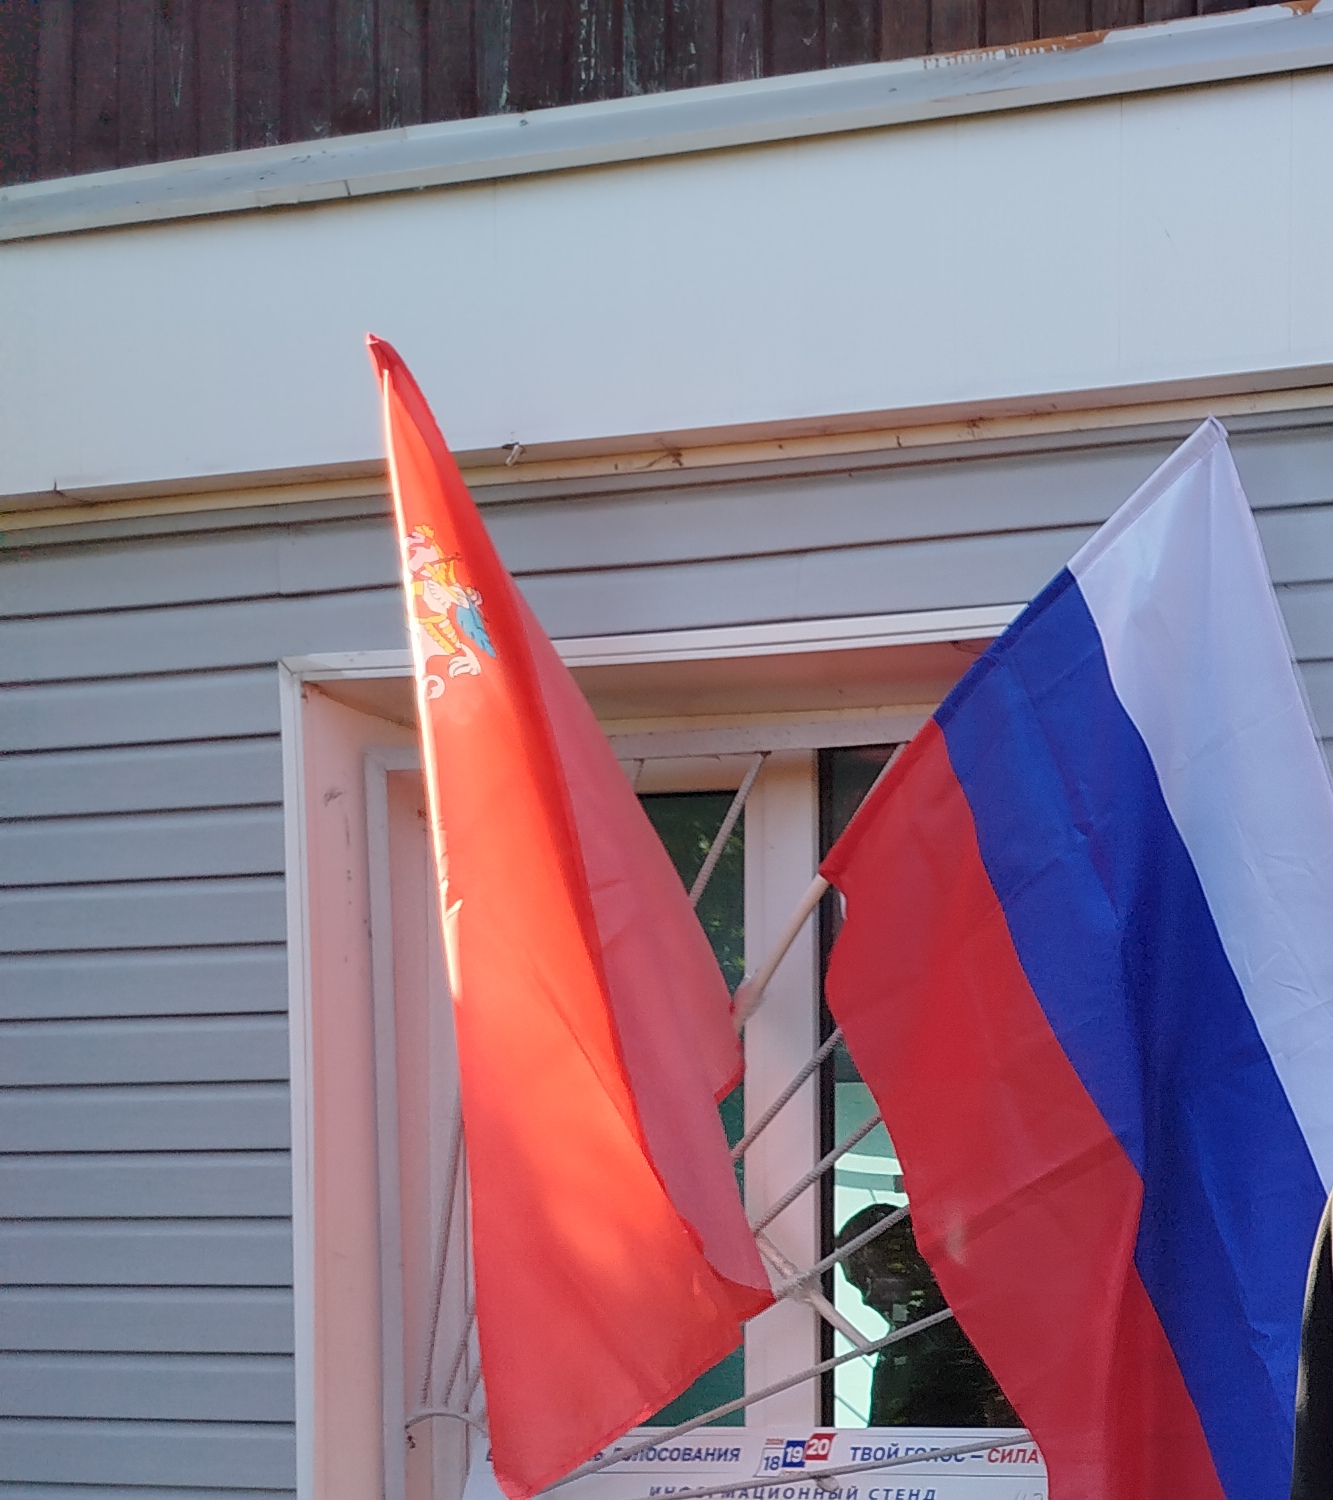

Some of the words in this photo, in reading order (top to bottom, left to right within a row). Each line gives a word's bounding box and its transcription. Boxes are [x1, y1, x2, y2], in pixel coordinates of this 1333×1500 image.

[764, 1455, 780, 1471] 18
[786, 1446, 804, 1462] 19
[807, 1438, 830, 1455] 20
[850, 1443, 899, 1462] ТВОЙ
[987, 1448, 1039, 1464] СИЛА
